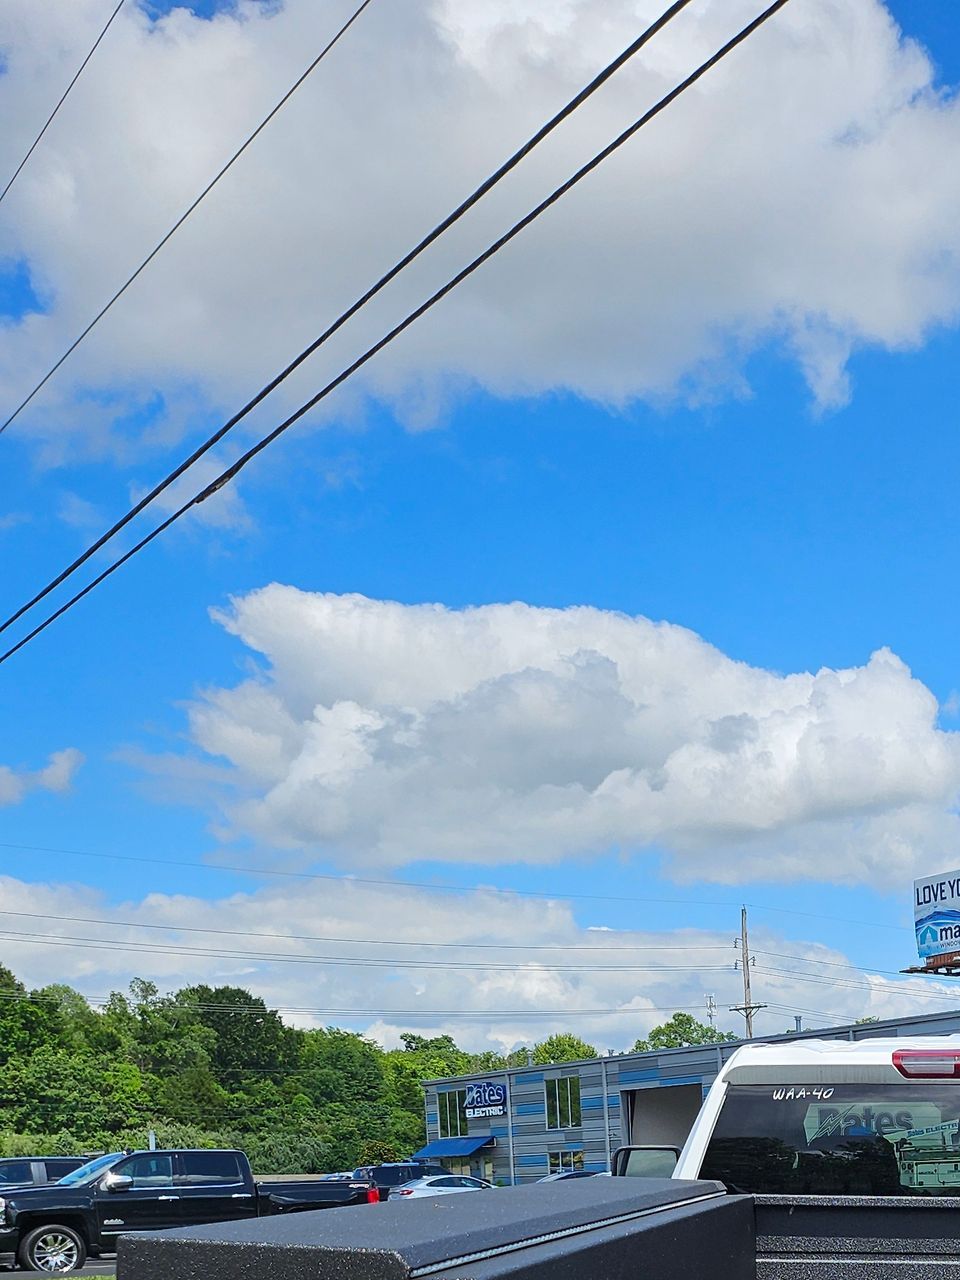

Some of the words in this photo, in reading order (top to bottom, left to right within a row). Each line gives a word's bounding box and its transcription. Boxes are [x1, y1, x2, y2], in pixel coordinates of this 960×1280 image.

[916, 881, 947, 906] LOVE
[772, 1087, 835, 1100] WAA-40
[466, 1106, 503, 1117] ELECTRIC
